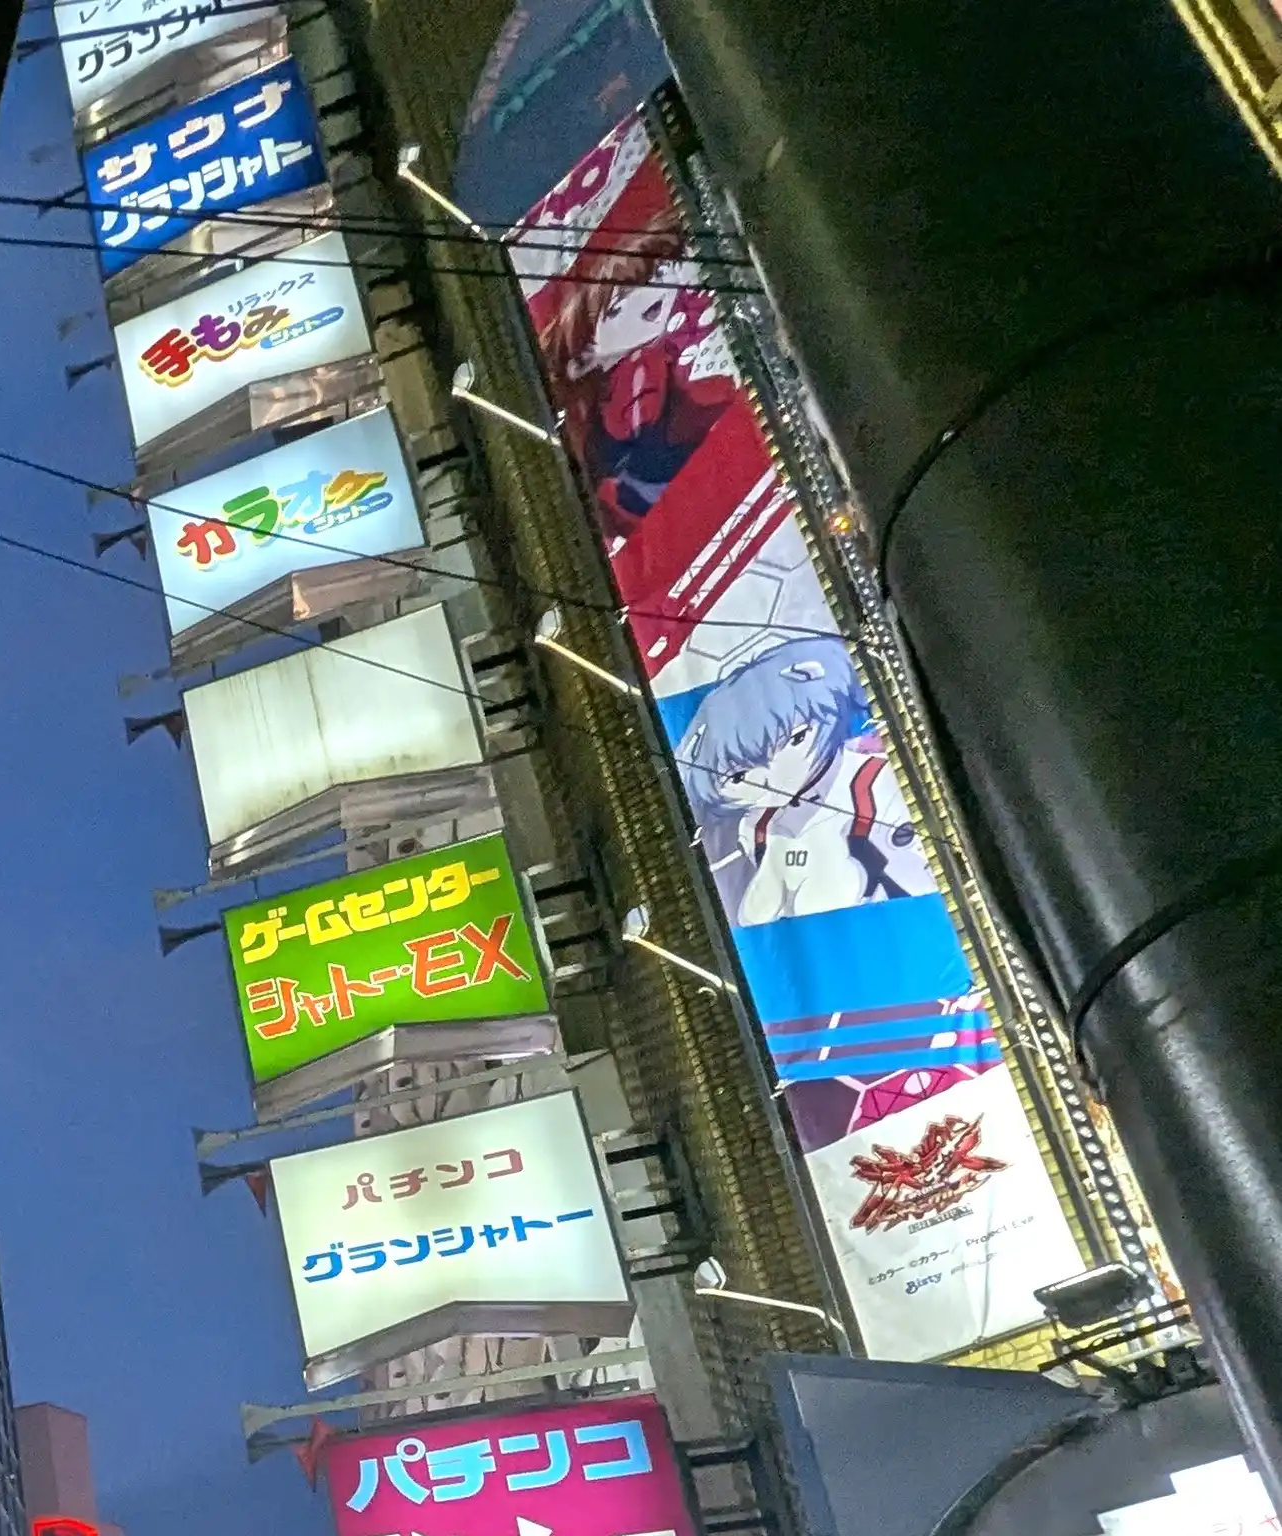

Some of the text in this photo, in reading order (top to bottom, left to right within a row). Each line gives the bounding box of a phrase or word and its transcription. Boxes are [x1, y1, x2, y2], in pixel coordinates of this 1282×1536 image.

[97, 80, 292, 193] サウナ
[100, 138, 313, 247] グランシャトー
[228, 273, 316, 315] リラックス
[269, 310, 342, 347] シャトー
[139, 304, 292, 380] 手もみ
[177, 470, 388, 565] カラオケ
[315, 493, 393, 532] シャトー
[784, 849, 809, 867] 00
[239, 861, 501, 965] ゲームセンター
[341, 1148, 525, 1211] パチンコ
[301, 1207, 594, 1283] グランシャトー
[904, 1272, 943, 1295] Bisty
[346, 1419, 653, 1513] パチンコ
